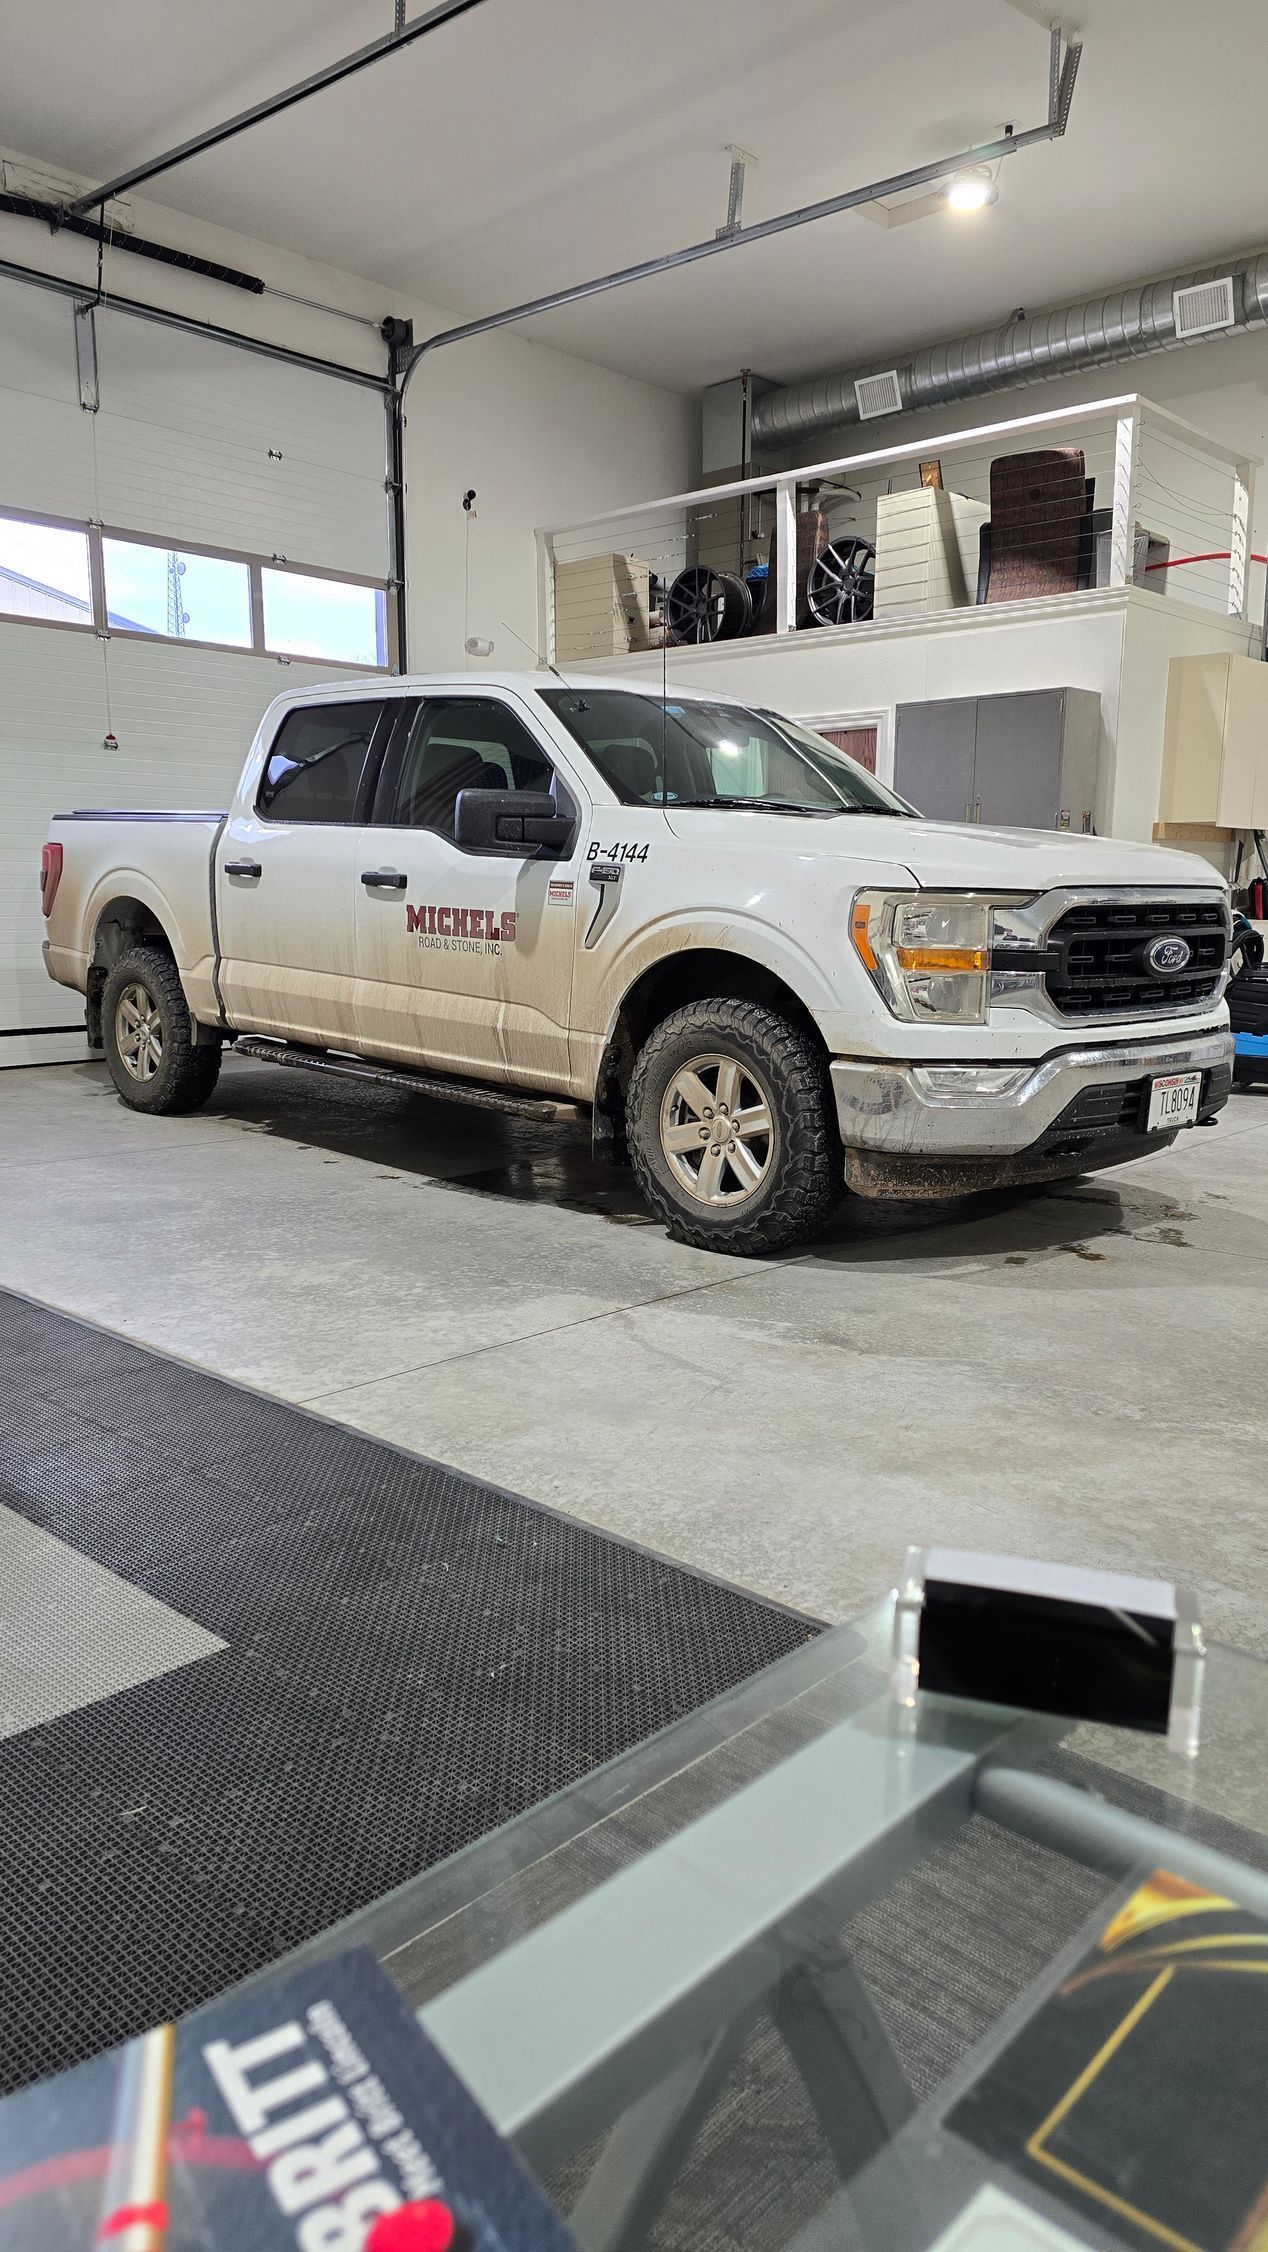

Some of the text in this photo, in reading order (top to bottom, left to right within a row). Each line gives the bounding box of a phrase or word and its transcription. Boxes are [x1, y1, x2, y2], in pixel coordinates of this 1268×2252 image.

[586, 842, 650, 863] B-4144
[549, 890, 572, 898] MICHELS
[406, 904, 516, 942] MICHELS
[418, 936, 503, 956] ROAD & STONE, INC.
[1161, 946, 1184, 965] Ford
[1160, 1086, 1196, 1116] TL8094
